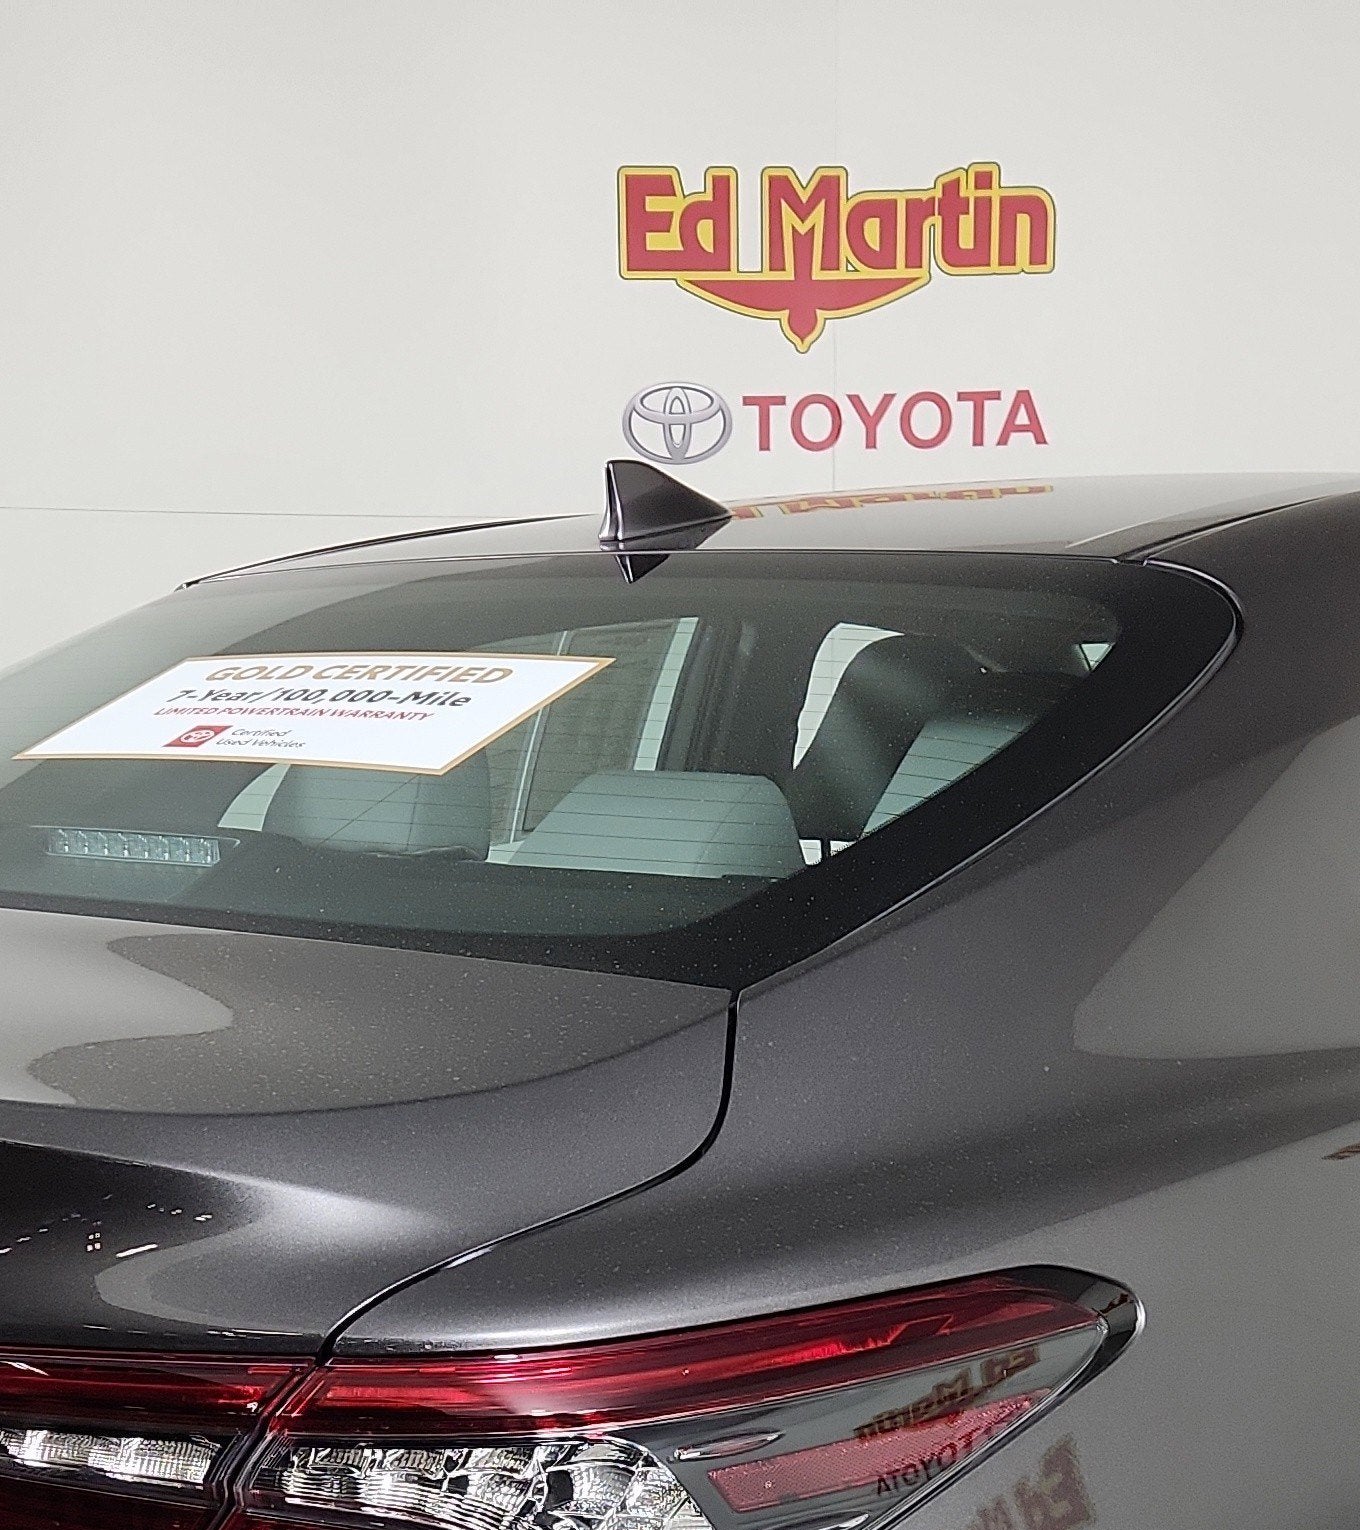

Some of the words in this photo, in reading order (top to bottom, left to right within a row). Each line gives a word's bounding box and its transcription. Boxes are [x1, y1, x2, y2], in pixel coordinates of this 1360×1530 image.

[617, 166, 737, 279] Ed
[761, 162, 1056, 275] Martin
[743, 390, 1048, 452] TOYOTA
[205, 664, 314, 683] GOLD
[310, 664, 514, 685] CERTIFIED
[166, 687, 472, 708] 7-Year/100,000-Mile
[153, 707, 220, 716] LIMITED
[217, 707, 331, 718] POWERTRAIN
[328, 708, 435, 722] WARRANTY
